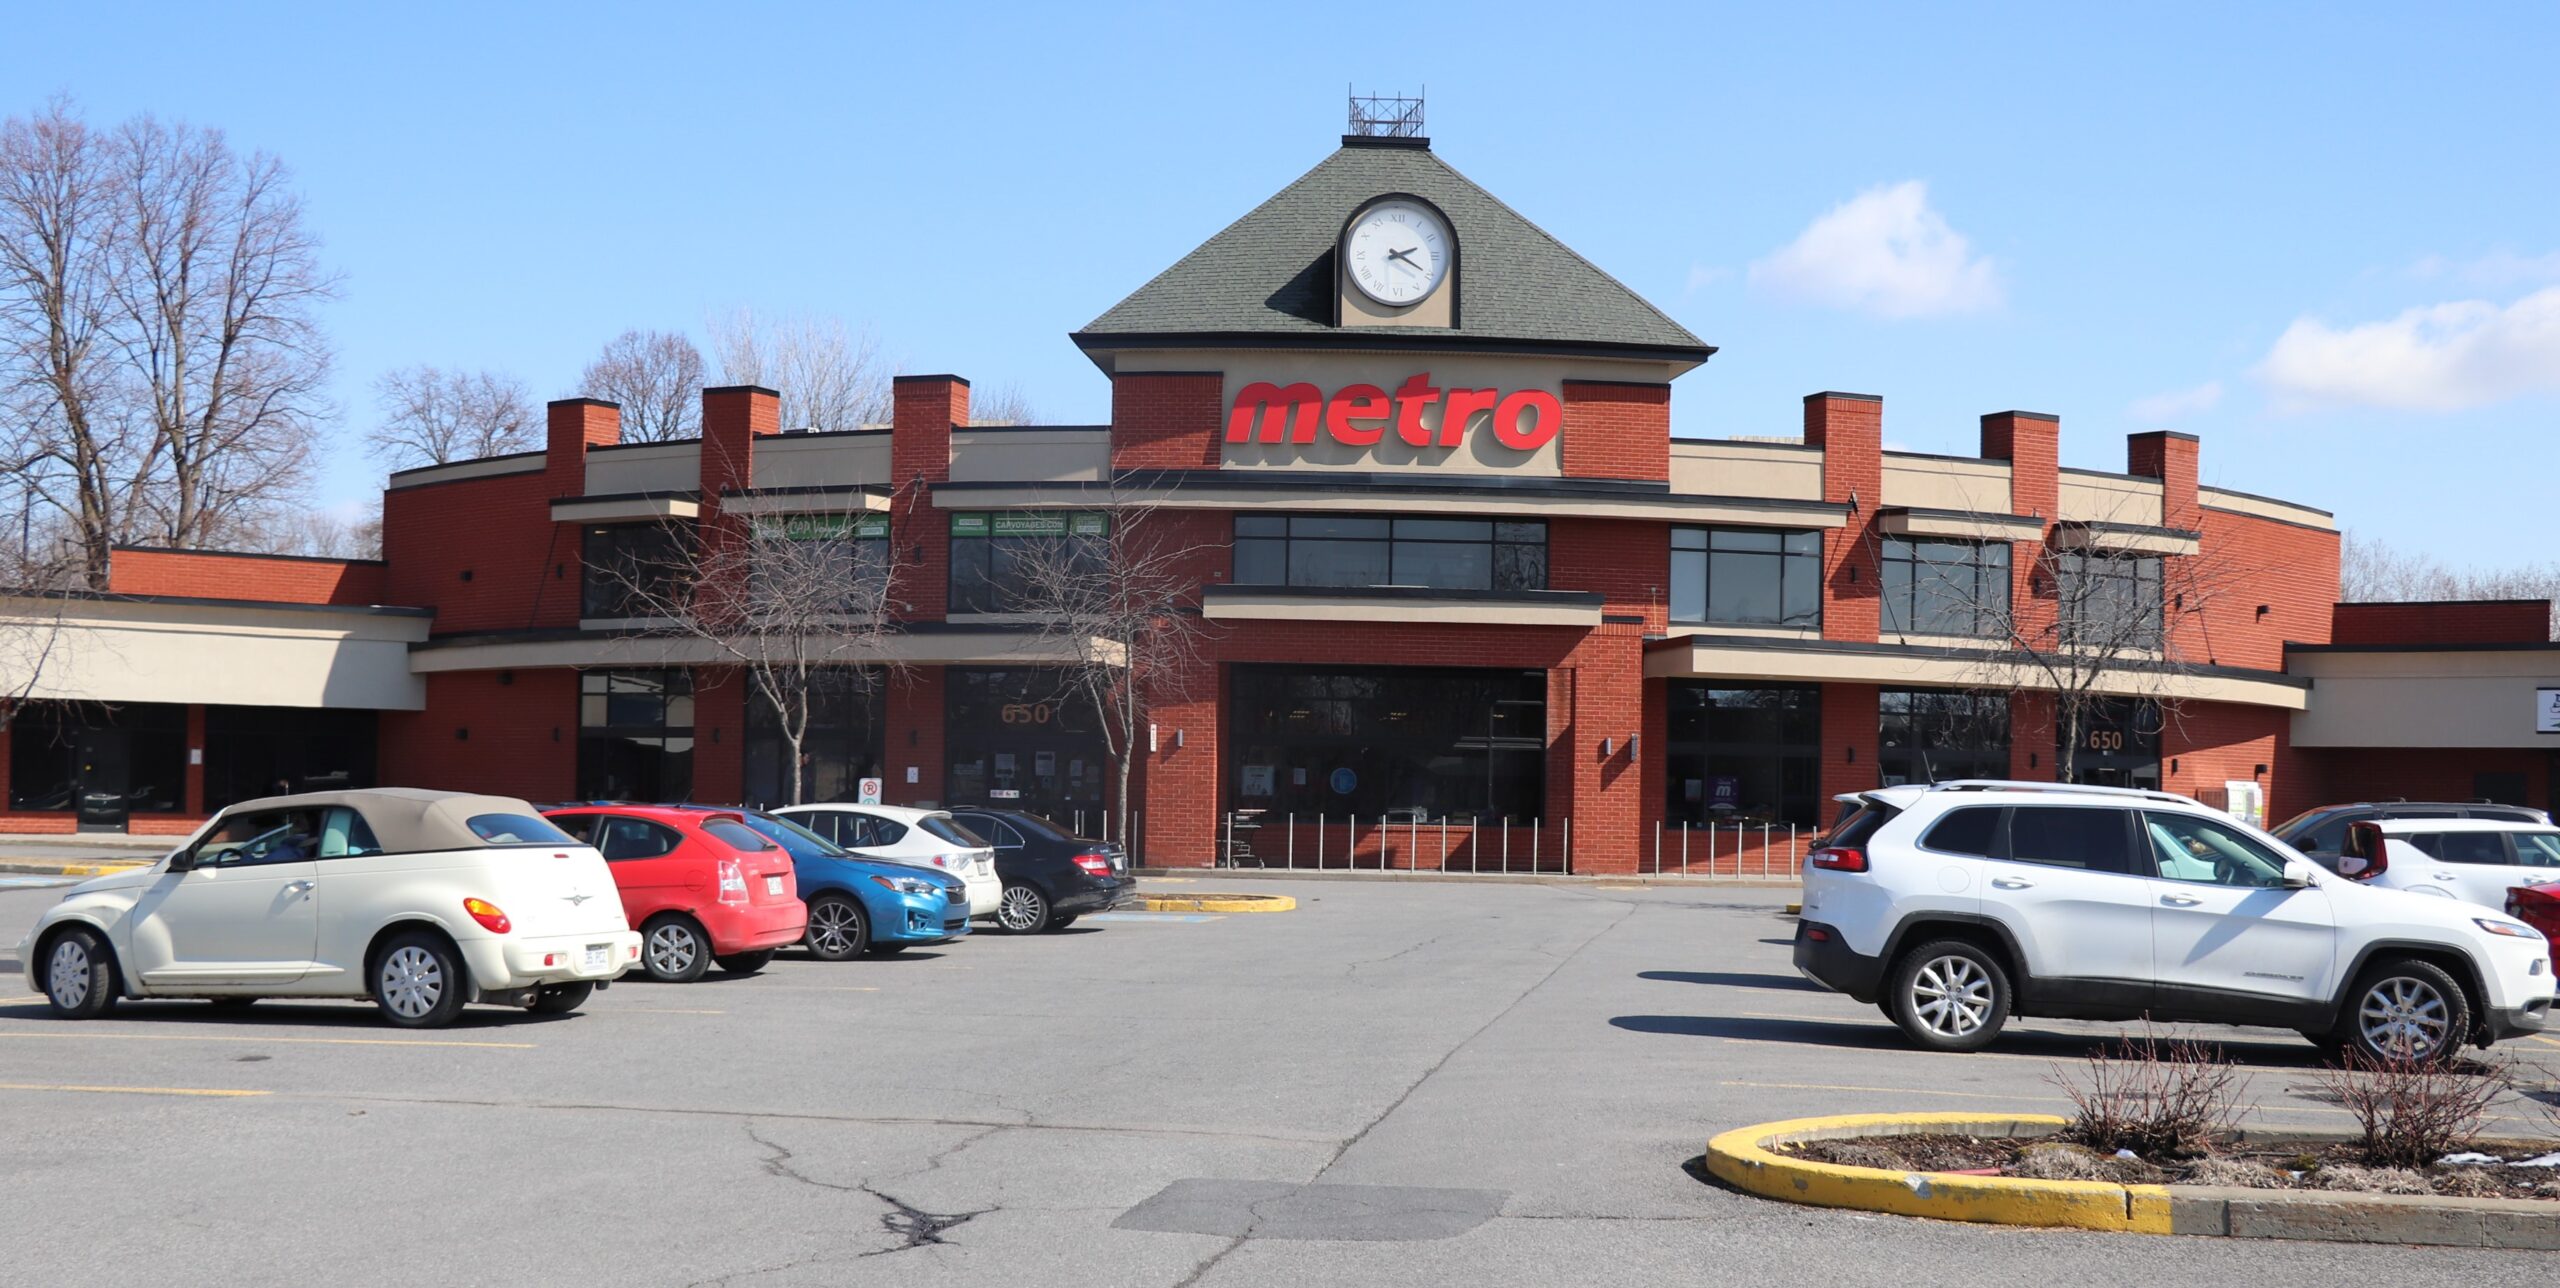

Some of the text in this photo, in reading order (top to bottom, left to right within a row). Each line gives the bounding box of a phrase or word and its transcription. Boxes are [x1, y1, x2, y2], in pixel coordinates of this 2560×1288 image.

[1390, 214, 1406, 222] XII
[1371, 218, 1384, 229] XI
[1361, 232, 1371, 240] X
[1426, 233, 1437, 242] II
[1356, 250, 1366, 260] IX
[1430, 251, 1440, 261] III
[1360, 265, 1372, 280] VIII
[1424, 271, 1435, 280] IV
[1373, 280, 1385, 292] VII
[1392, 288, 1403, 297] VI
[1225, 372, 1563, 450] metro
[1001, 703, 1050, 723] 650
[2090, 730, 2122, 749] 650
[1715, 785, 1731, 796] m
